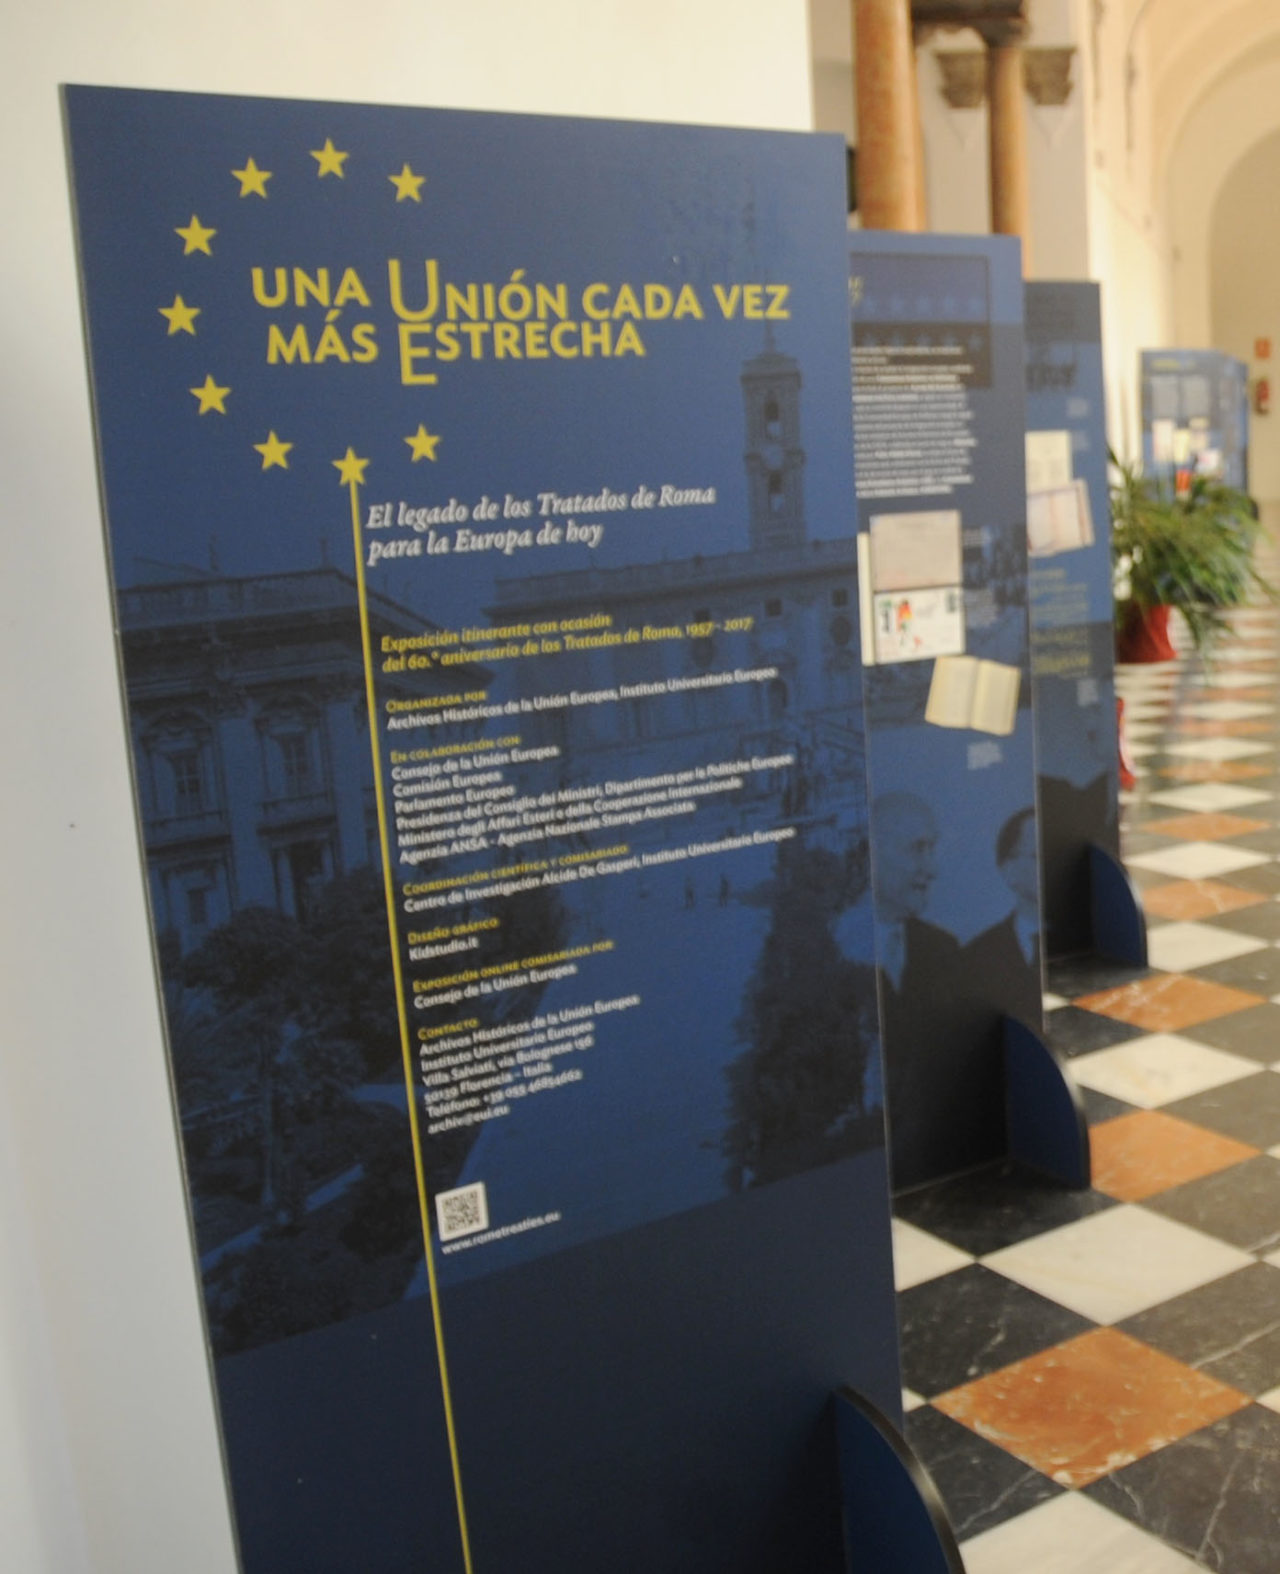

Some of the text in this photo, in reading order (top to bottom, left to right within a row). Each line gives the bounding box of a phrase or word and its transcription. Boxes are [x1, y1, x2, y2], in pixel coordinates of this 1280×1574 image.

[252, 258, 790, 322] UNA UNIÓN CADA VEZ
[267, 309, 646, 385] MÁS ESTRECHA
[366, 484, 716, 532] El legado de los Tratados de Roma
[367, 519, 604, 567] para la Europa de hoy
[381, 613, 612, 652] Exposición itinerante con ocasión
[382, 656, 405, 673] del
[441, 644, 519, 666] aniversario
[522, 640, 538, 656] de
[541, 638, 561, 653] los
[563, 631, 622, 650] Tratados
[624, 628, 640, 643] de
[642, 625, 683, 641] Roma,
[686, 621, 714, 637] 1957
[723, 616, 753, 632] 2017
[387, 667, 778, 731] Archivos Históricos de la Unión Europea, Instituto Universitario Europeo
[391, 746, 560, 781] Consejo de la Unión Europea
[393, 771, 503, 797] Comisión Europea
[395, 784, 516, 814] Parlamento Europeo
[396, 810, 462, 831] Presidenza
[484, 796, 537, 816] Consiglio
[604, 773, 676, 796] Dipartimento
[676, 770, 695, 786] per
[706, 761, 750, 778] Politiche
[398, 826, 456, 847] Ministero
[457, 820, 486, 838] degli
[488, 815, 521, 831] Affari
[523, 809, 555, 825] Esteri
[565, 802, 592, 817] della
[594, 789, 668, 812] Cooperazione
[668, 776, 743, 799] Internazionale
[400, 845, 449, 866] Agenzia
[451, 836, 489, 855] ANSA
[497, 828, 544, 848] Agenzia
[544, 817, 601, 837] Nazionale
[601, 808, 643, 828] Stampa
[644, 801, 696, 818] Associata
[404, 826, 796, 913] Centro de Investigación Alcide De Gasperi, Instituto Universitario Europeo
[409, 936, 479, 962] Kidstudio.it
[414, 963, 577, 1009] Consejo de la Unión Europea
[419, 994, 641, 1057] Archivos Históricos de la Unión Europea
[421, 1021, 594, 1072] Instituto Universitario Europeo
[422, 1071, 449, 1088] Villa
[460, 1072, 514, 1094] Florencia
[523, 1062, 553, 1078] Italia
